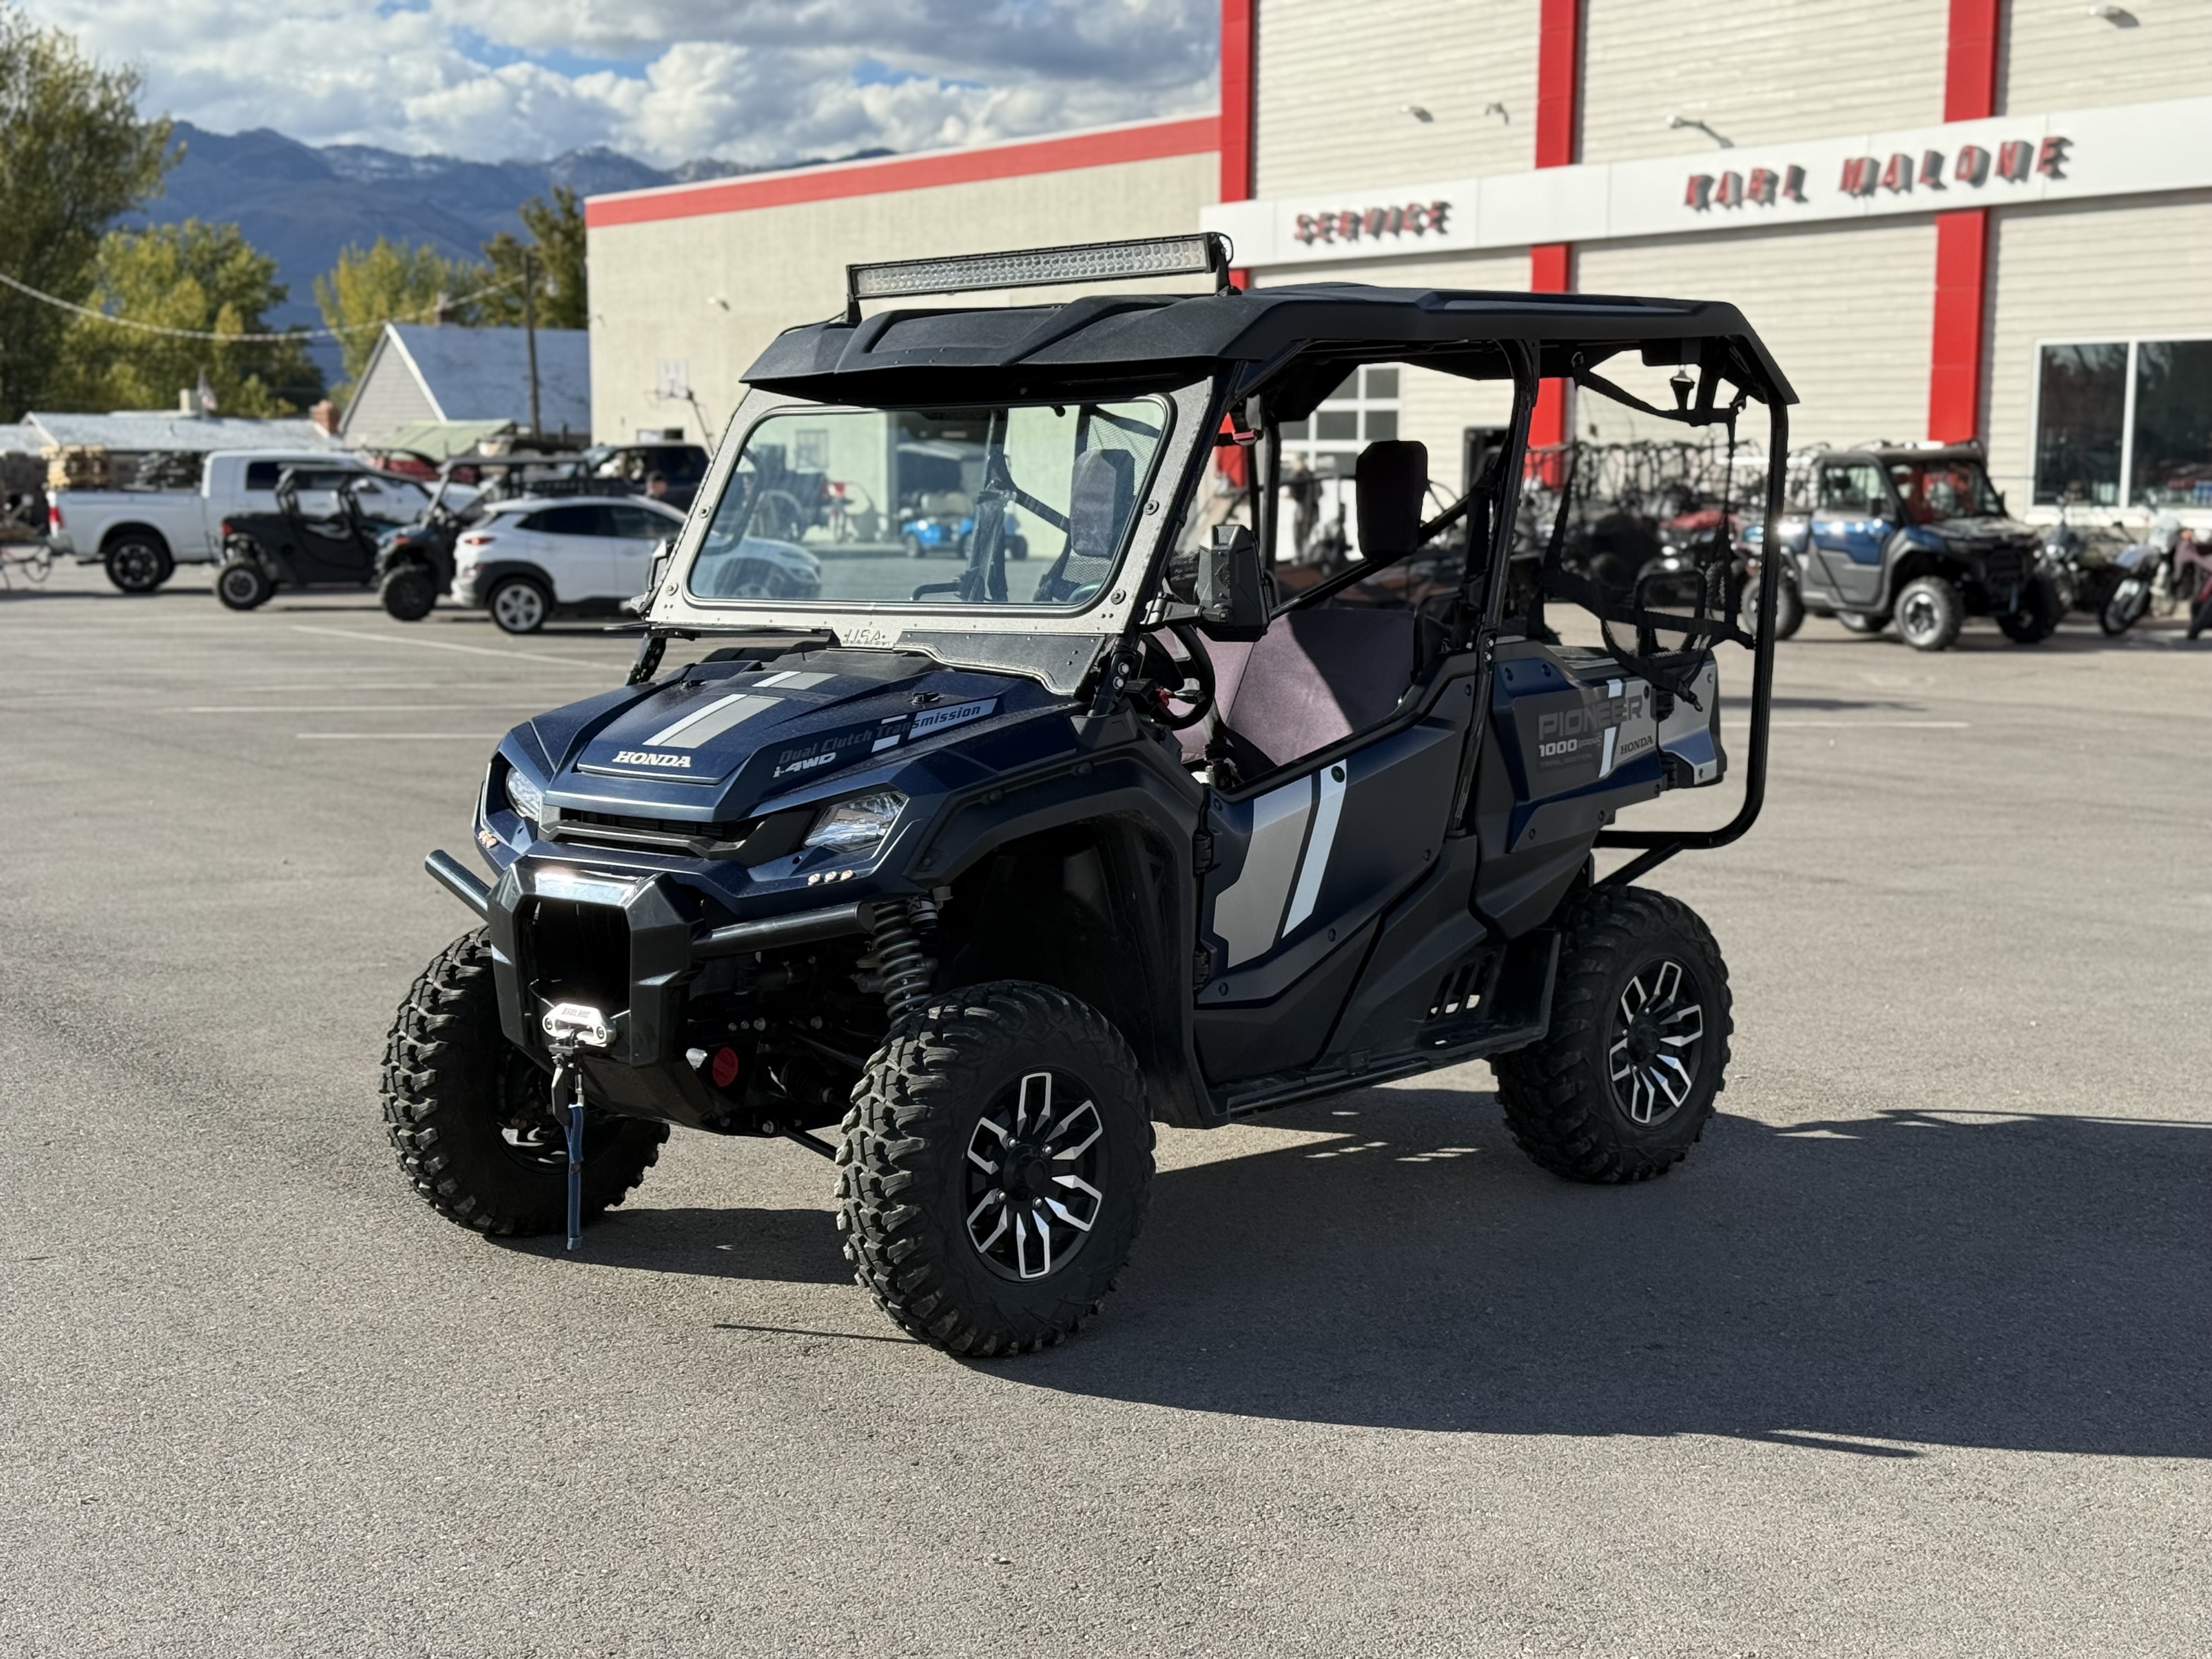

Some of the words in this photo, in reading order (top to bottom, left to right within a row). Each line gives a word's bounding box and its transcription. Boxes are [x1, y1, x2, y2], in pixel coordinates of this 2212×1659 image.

[1684, 165, 1809, 212] KARL
[1839, 137, 2074, 198] MALONE
[1294, 201, 1453, 245] SERVICE
[845, 629, 881, 643] USA
[778, 742, 817, 765] Dual
[821, 729, 873, 753] Clutch
[877, 705, 981, 738] Transmission
[1538, 695, 1643, 741] PIONEER
[612, 751, 691, 768] HONDA
[1620, 735, 1654, 755] HONDA
[773, 752, 836, 778] i-4WD
